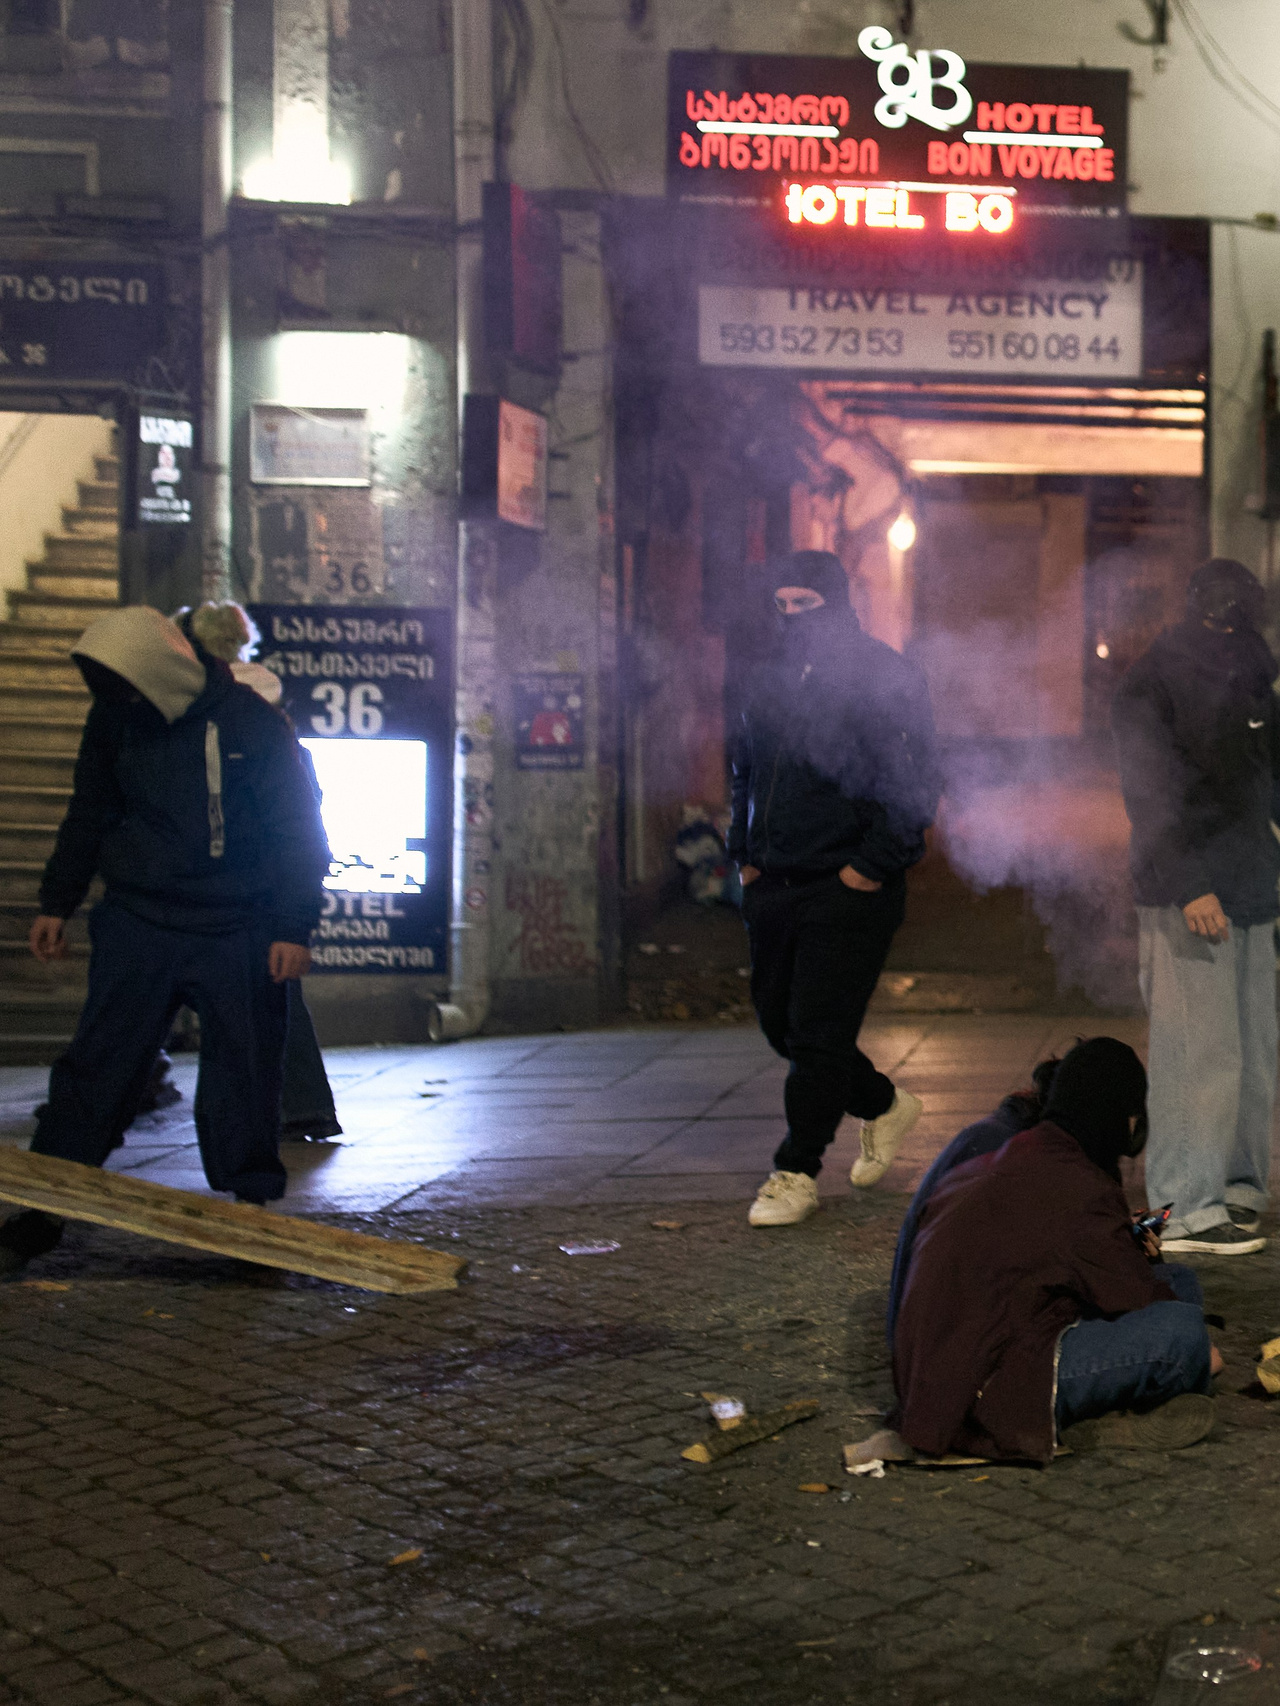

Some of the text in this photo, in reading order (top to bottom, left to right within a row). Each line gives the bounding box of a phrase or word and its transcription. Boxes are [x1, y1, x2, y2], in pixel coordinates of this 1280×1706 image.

[686, 90, 850, 127] სასტუმრო
[976, 101, 1105, 135] HOTEL
[679, 131, 880, 175] ბონვოიაჟი
[927, 141, 1116, 182] BON VOYAGE
[944, 192, 1014, 233] BO
[787, 285, 1109, 320] TRAVEL AGENCY
[326, 560, 371, 594] 36
[272, 616, 425, 645] სასტუმრო
[262, 651, 435, 680] რუსთაველი
[310, 681, 384, 738] 36
